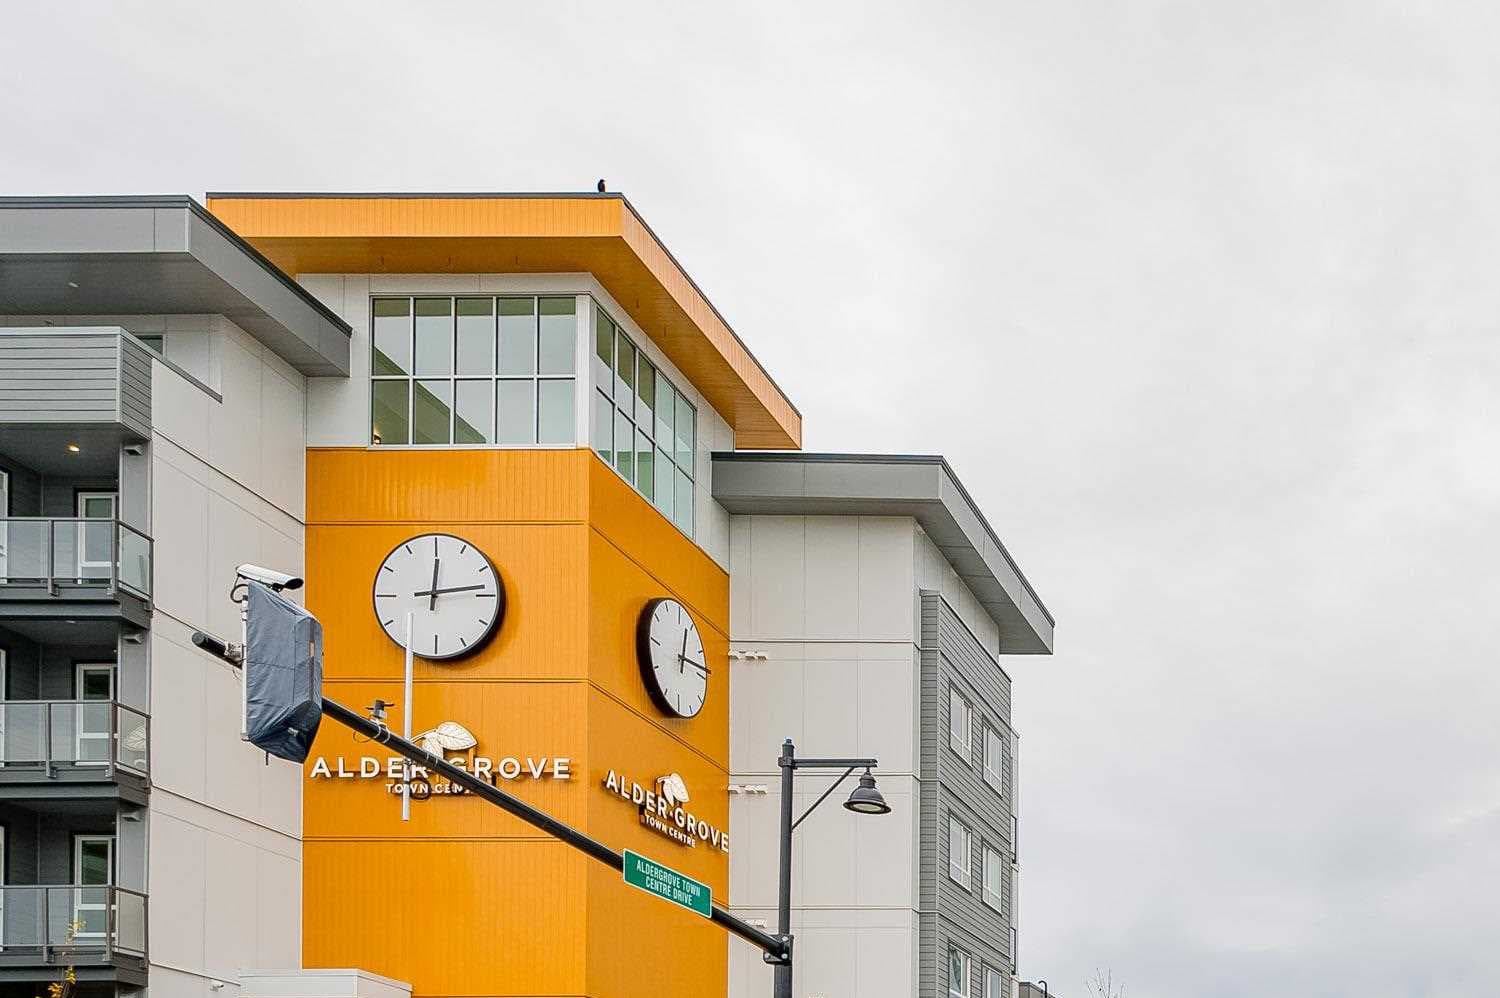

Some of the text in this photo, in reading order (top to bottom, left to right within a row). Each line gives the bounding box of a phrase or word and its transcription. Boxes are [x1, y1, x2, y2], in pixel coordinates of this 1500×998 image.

[310, 757, 428, 778] ALDER
[606, 769, 729, 853] ALDER GROVE
[645, 815, 696, 848] TOWN CENTRE
[636, 859, 701, 897] ALDERGROVE TOWN
[645, 876, 693, 906] CENTRE DRIVE
